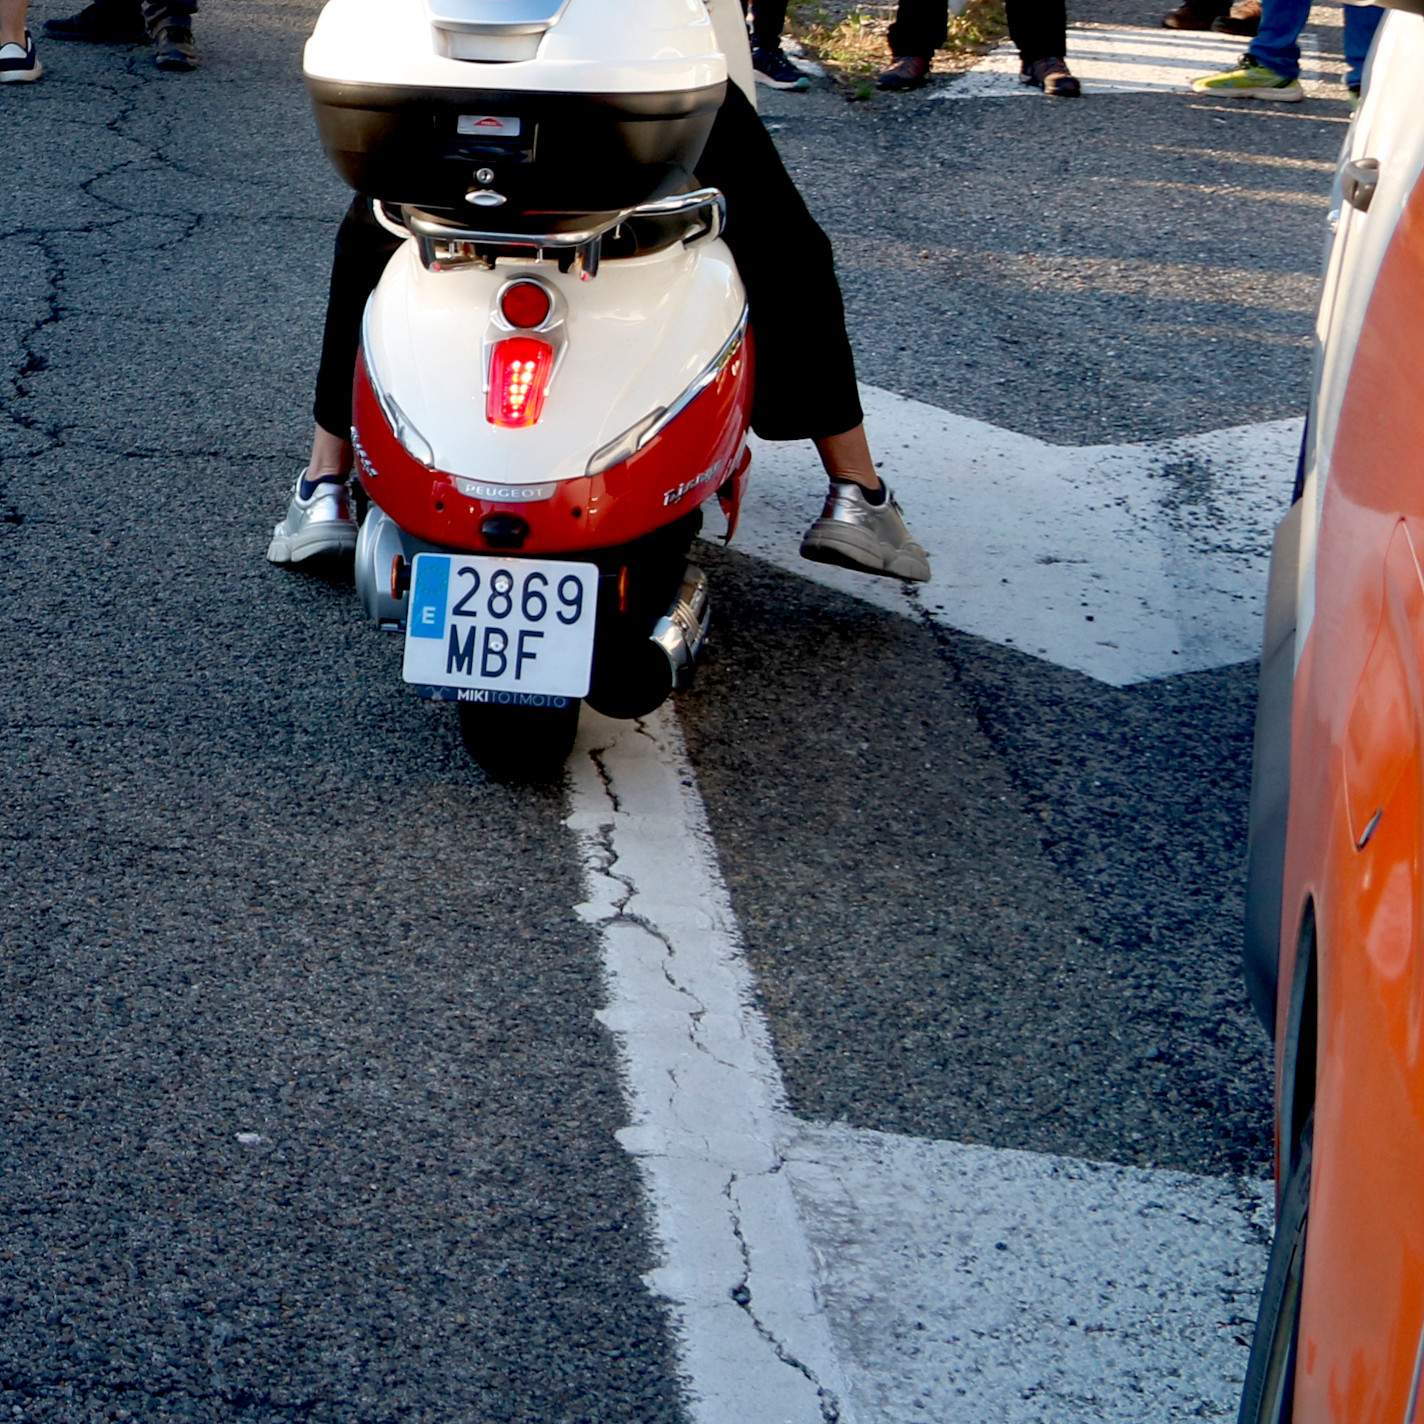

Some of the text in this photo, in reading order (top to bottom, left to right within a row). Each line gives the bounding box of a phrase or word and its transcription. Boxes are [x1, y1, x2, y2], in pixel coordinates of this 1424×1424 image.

[465, 484, 544, 497] PEUGEOT
[422, 605, 437, 625] E
[451, 565, 585, 627] 2869
[445, 623, 546, 680] MBF
